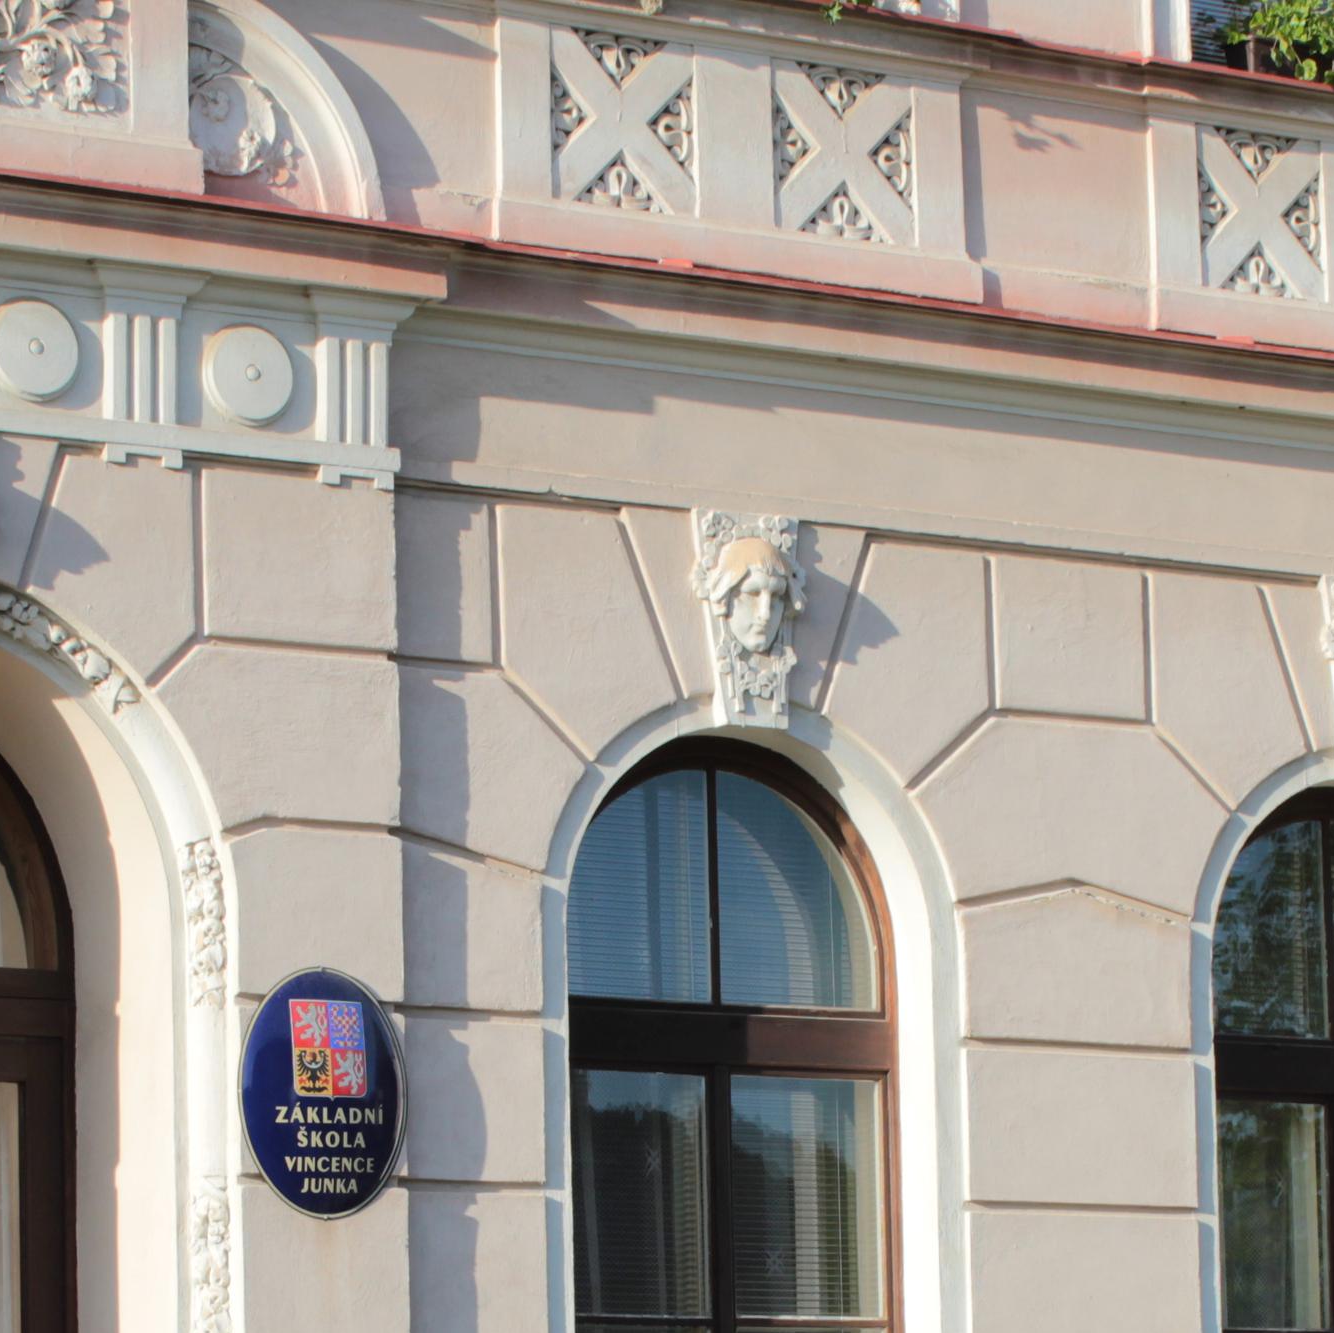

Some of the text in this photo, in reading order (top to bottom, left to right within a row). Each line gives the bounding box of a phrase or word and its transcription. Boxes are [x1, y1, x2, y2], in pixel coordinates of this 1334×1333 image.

[275, 1101, 383, 1125] ZÁKLADNÍ
[297, 1126, 366, 1148] ŠKOLA
[284, 1156, 375, 1173] VINCENCE
[300, 1178, 358, 1194] JUNKA
